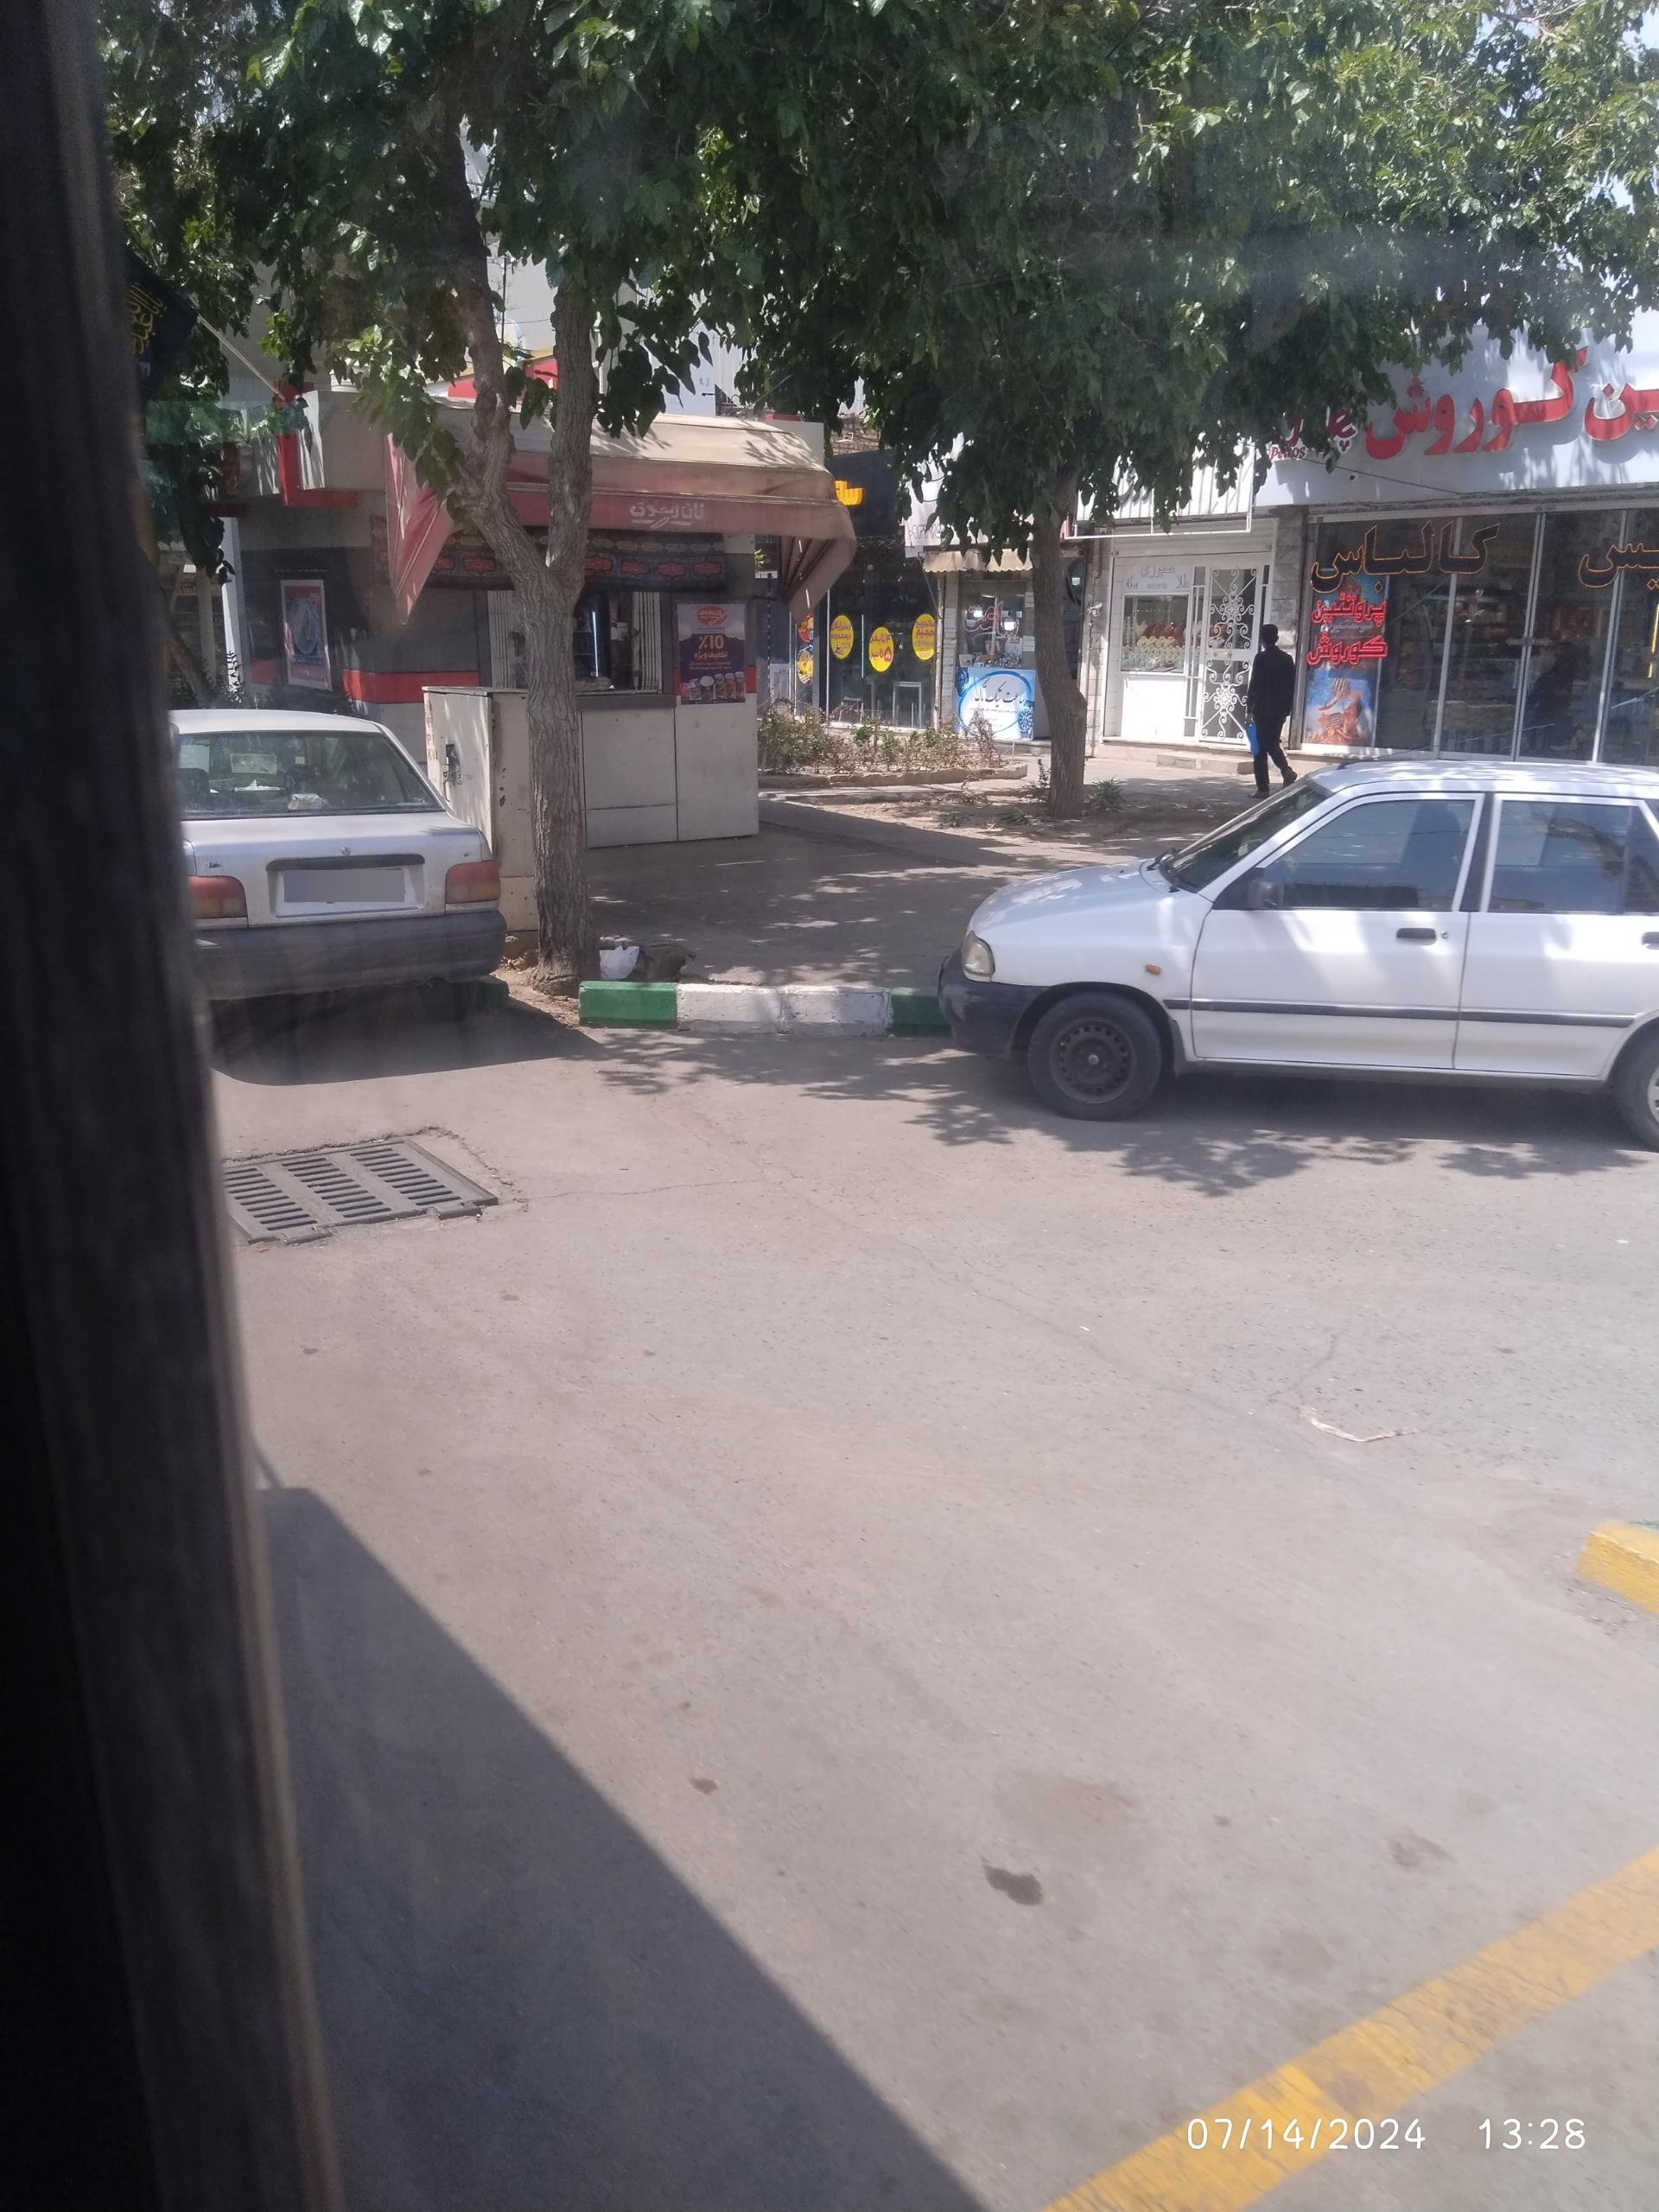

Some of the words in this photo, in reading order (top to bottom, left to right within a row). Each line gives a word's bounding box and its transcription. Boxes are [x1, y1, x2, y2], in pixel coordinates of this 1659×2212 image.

[1309, 519, 1501, 594] کالباس
[1311, 593, 1388, 627] پروتئین
[1306, 632, 1389, 664] کوروش
